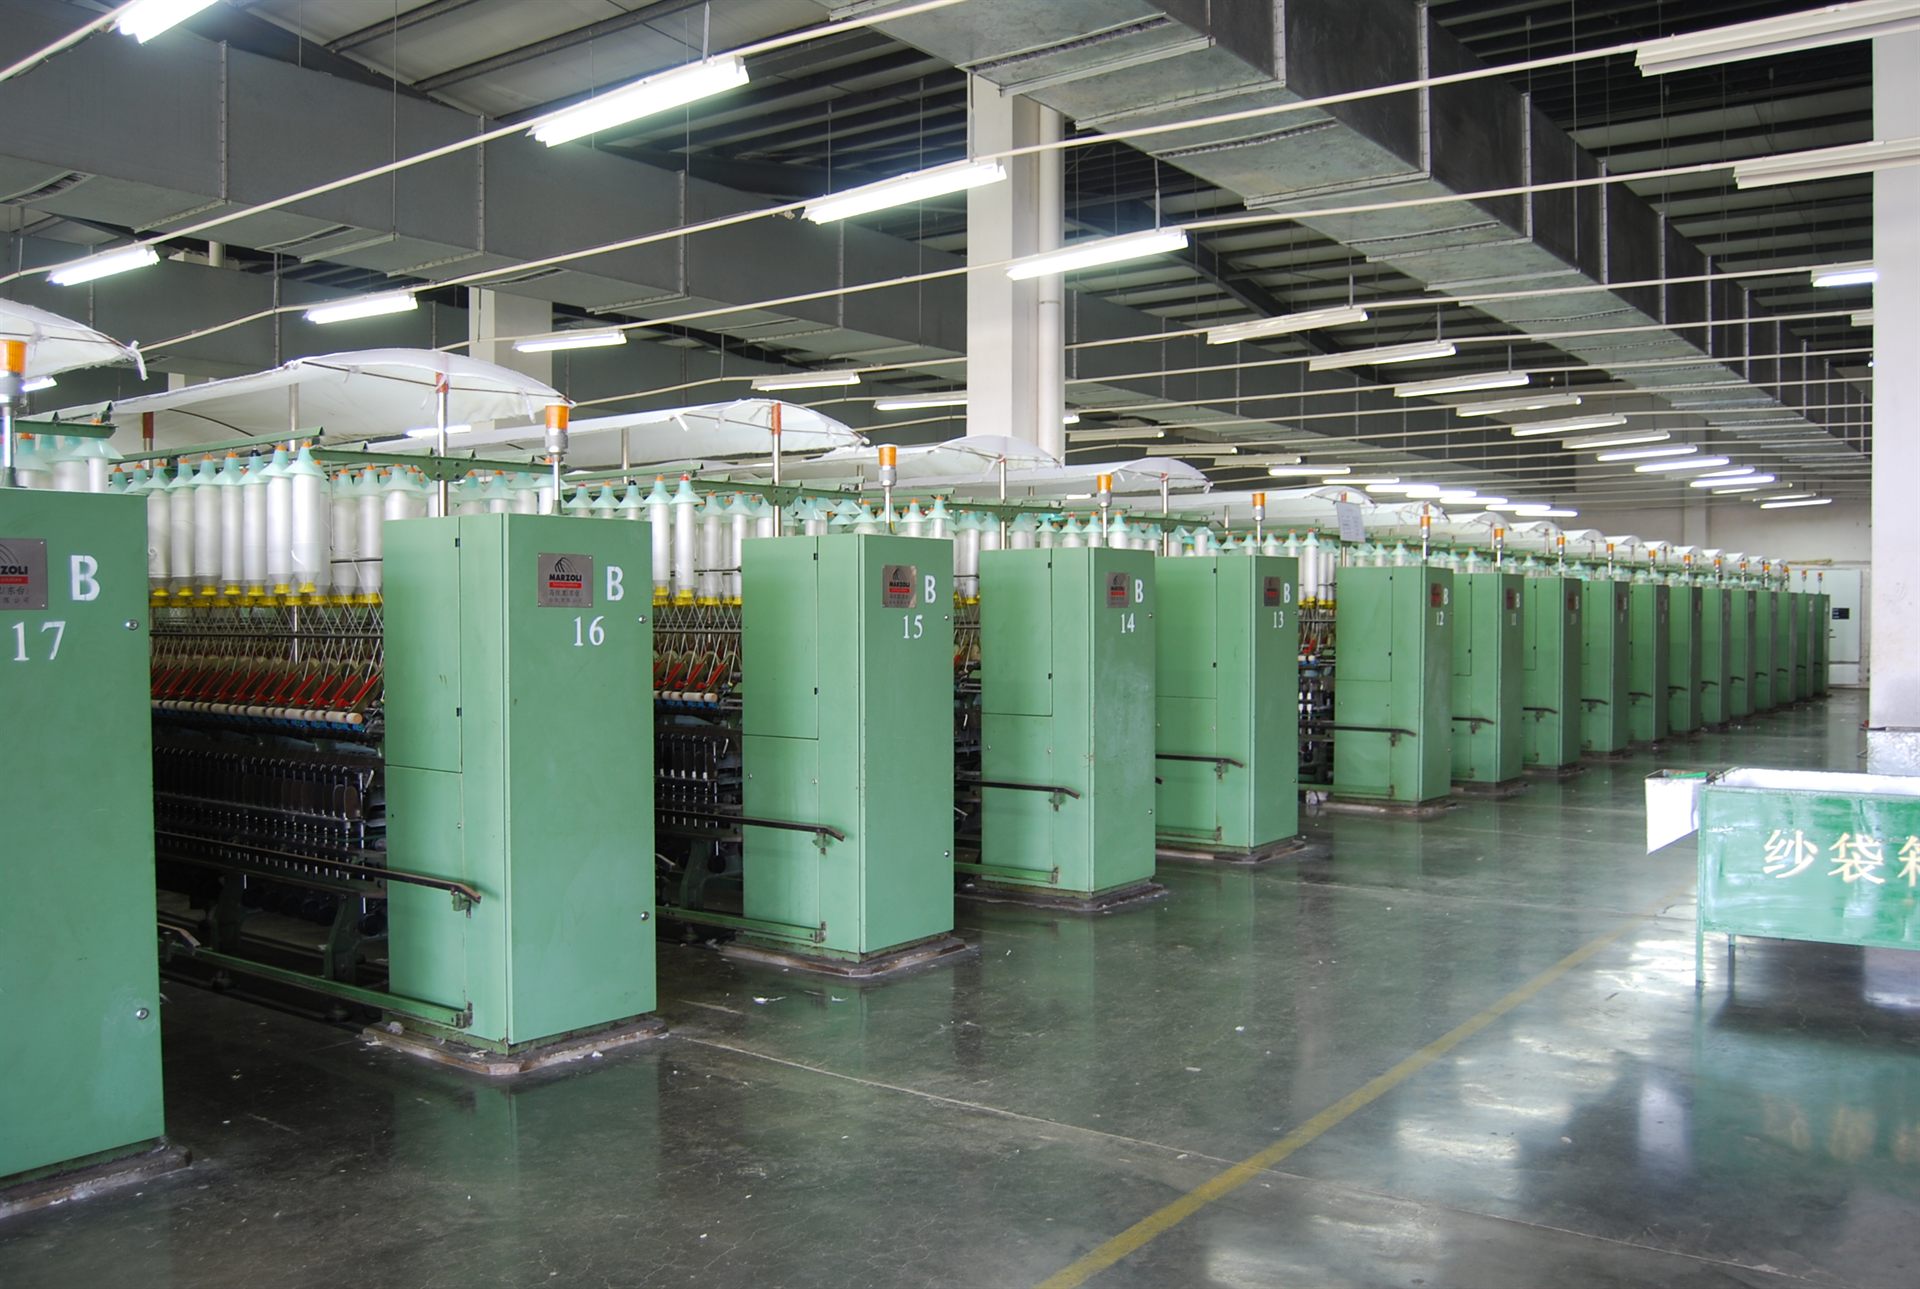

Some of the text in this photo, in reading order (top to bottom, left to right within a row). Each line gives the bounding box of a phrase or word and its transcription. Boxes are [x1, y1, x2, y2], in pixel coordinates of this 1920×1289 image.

[70, 555, 100, 601] B
[607, 566, 624, 601] B
[925, 574, 936, 604] B
[1135, 579, 1144, 603] B
[1284, 583, 1291, 604] B
[574, 615, 605, 647] 16
[903, 614, 923, 639] 15
[1121, 613, 1136, 634] 14
[1273, 611, 1284, 629] 13
[1436, 611, 1444, 626] 12
[12, 621, 66, 661] 17
